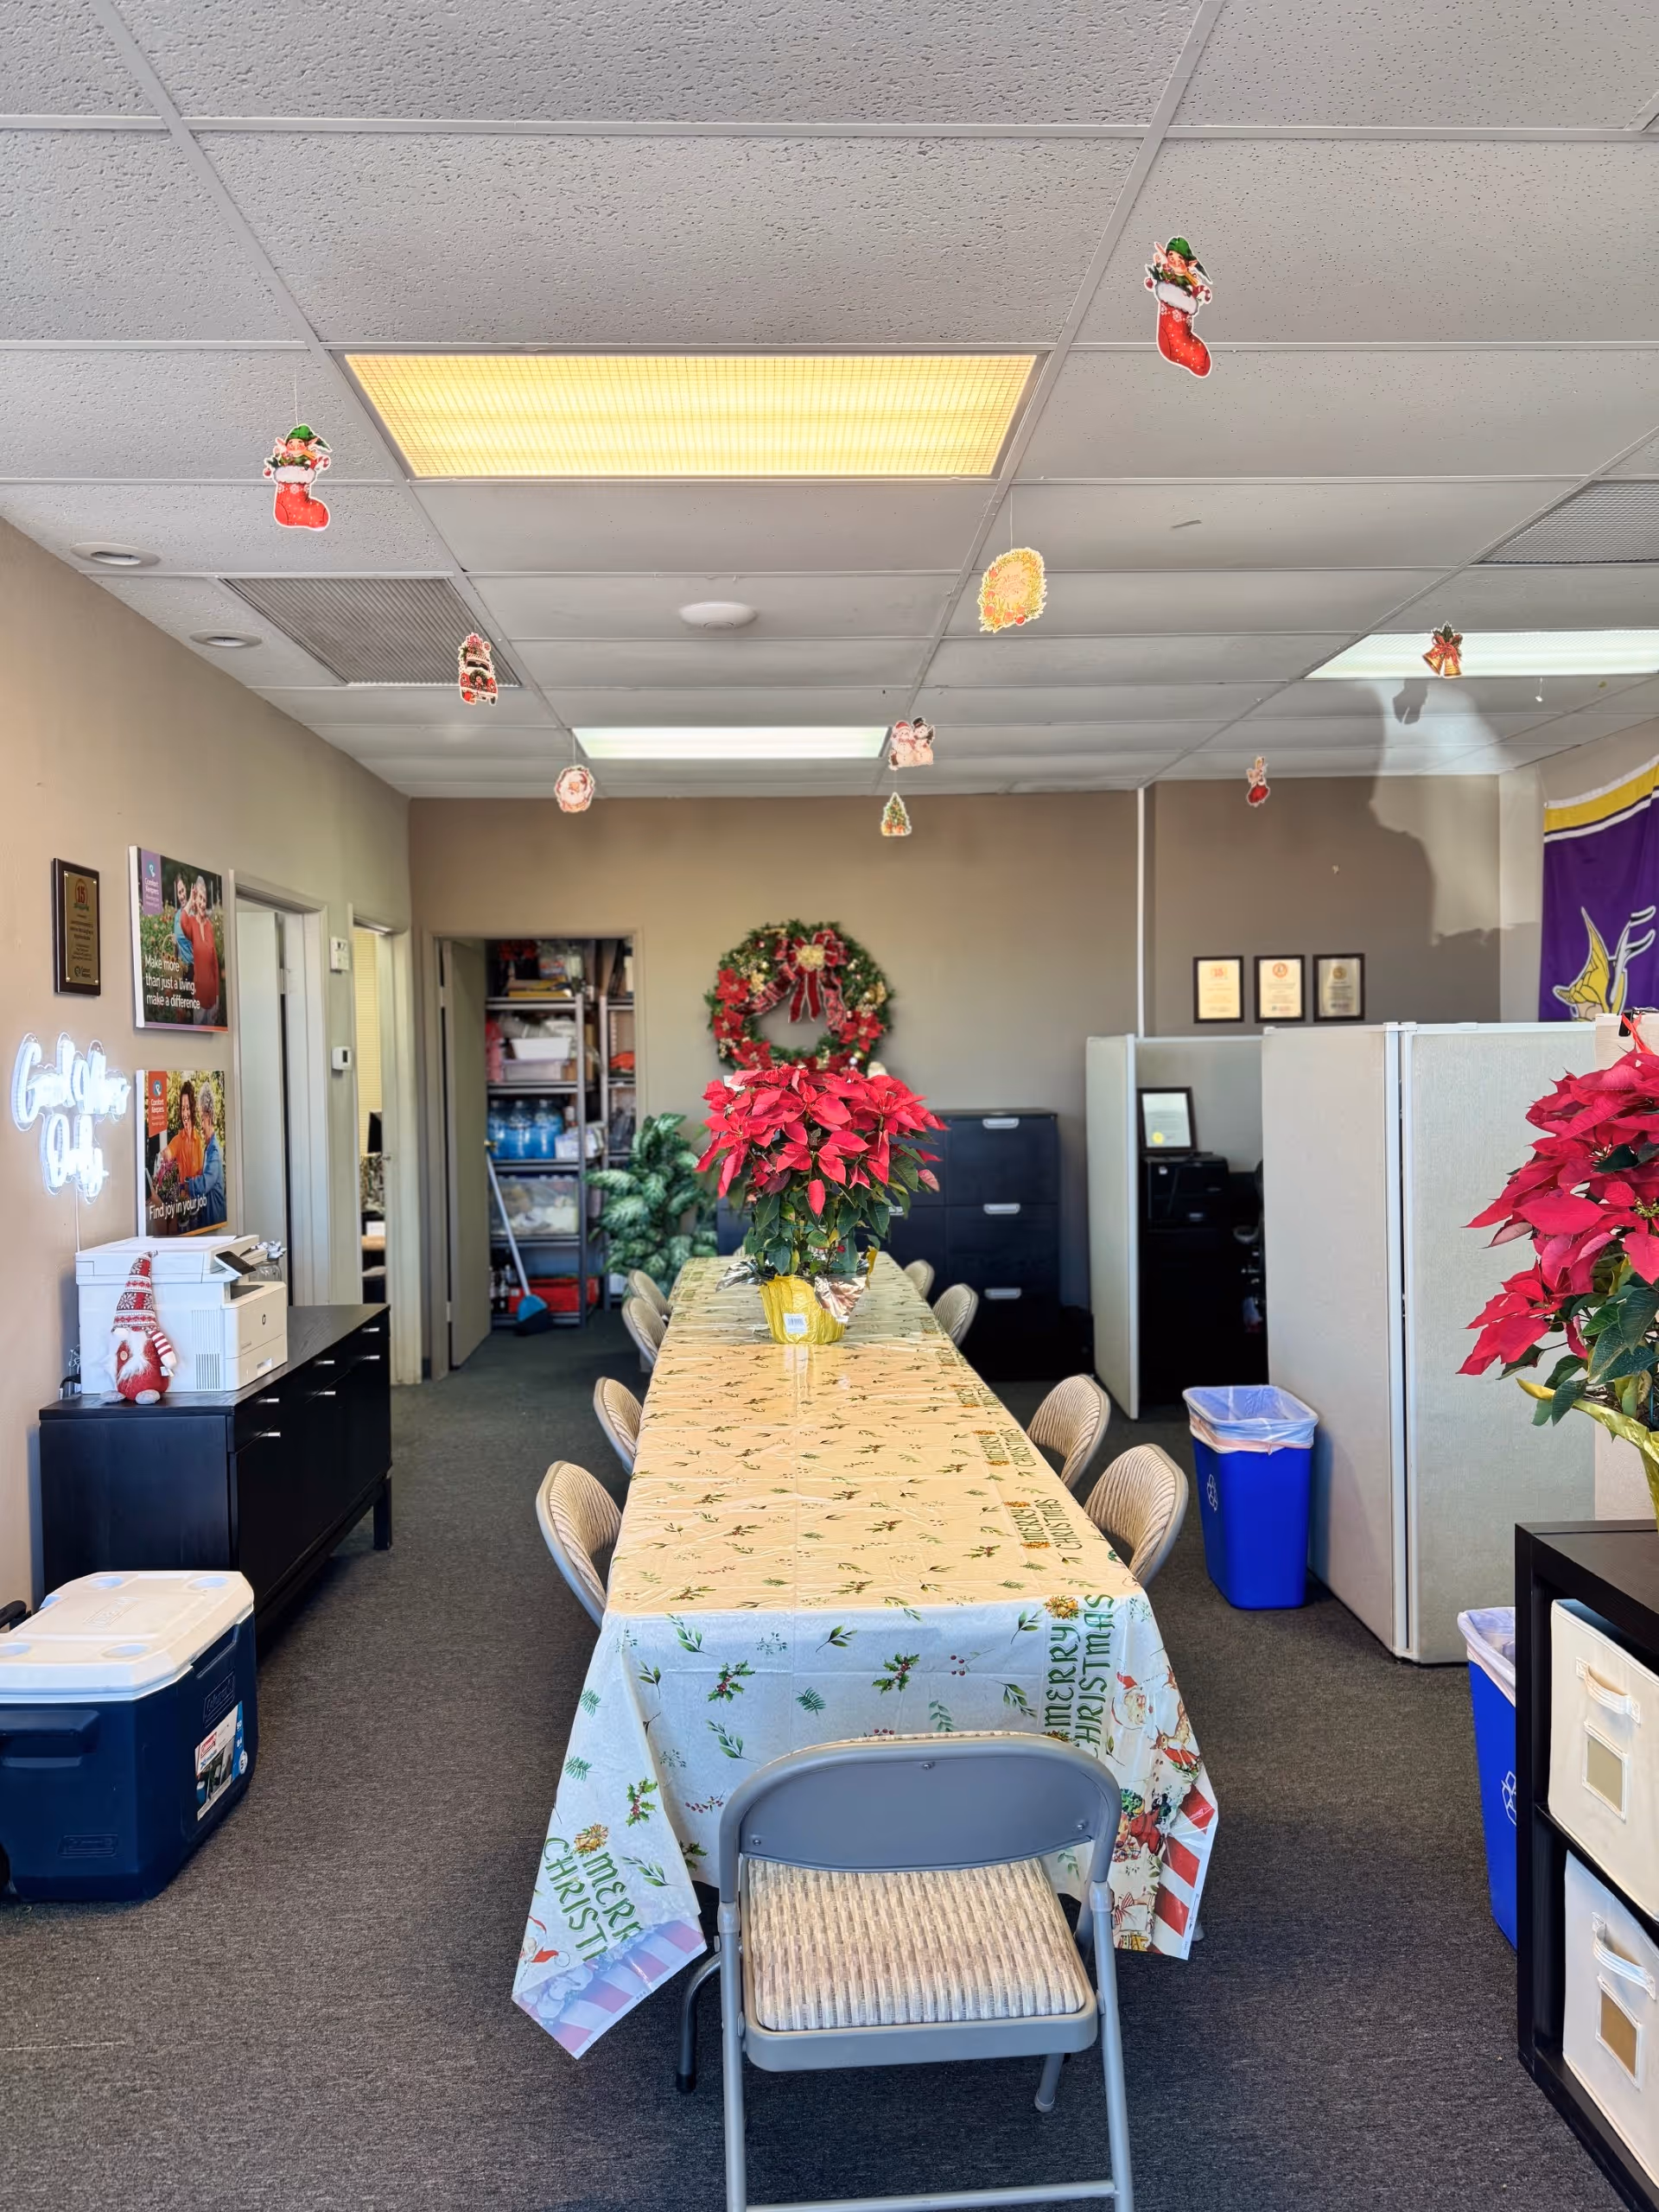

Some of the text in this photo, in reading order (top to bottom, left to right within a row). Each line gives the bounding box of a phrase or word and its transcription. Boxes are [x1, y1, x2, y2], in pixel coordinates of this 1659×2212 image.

[144, 954, 180, 972] Make more
[145, 973, 197, 995] than just a living,
[146, 992, 200, 1009] make a difference
[149, 1195, 207, 1220] Find joy in your job
[978, 1435, 1010, 1459] MERRY
[1000, 1428, 1036, 1467] CHRISTMAS
[1010, 1509, 1049, 1541] MERRY
[1033, 1498, 1083, 1550] CHRISTMAS
[1045, 1624, 1081, 1727] MERRY
[1075, 1594, 1115, 1759] HRISTMAS
[543, 1837, 608, 1961] CHRIST
[582, 1851, 645, 1943] MERR
